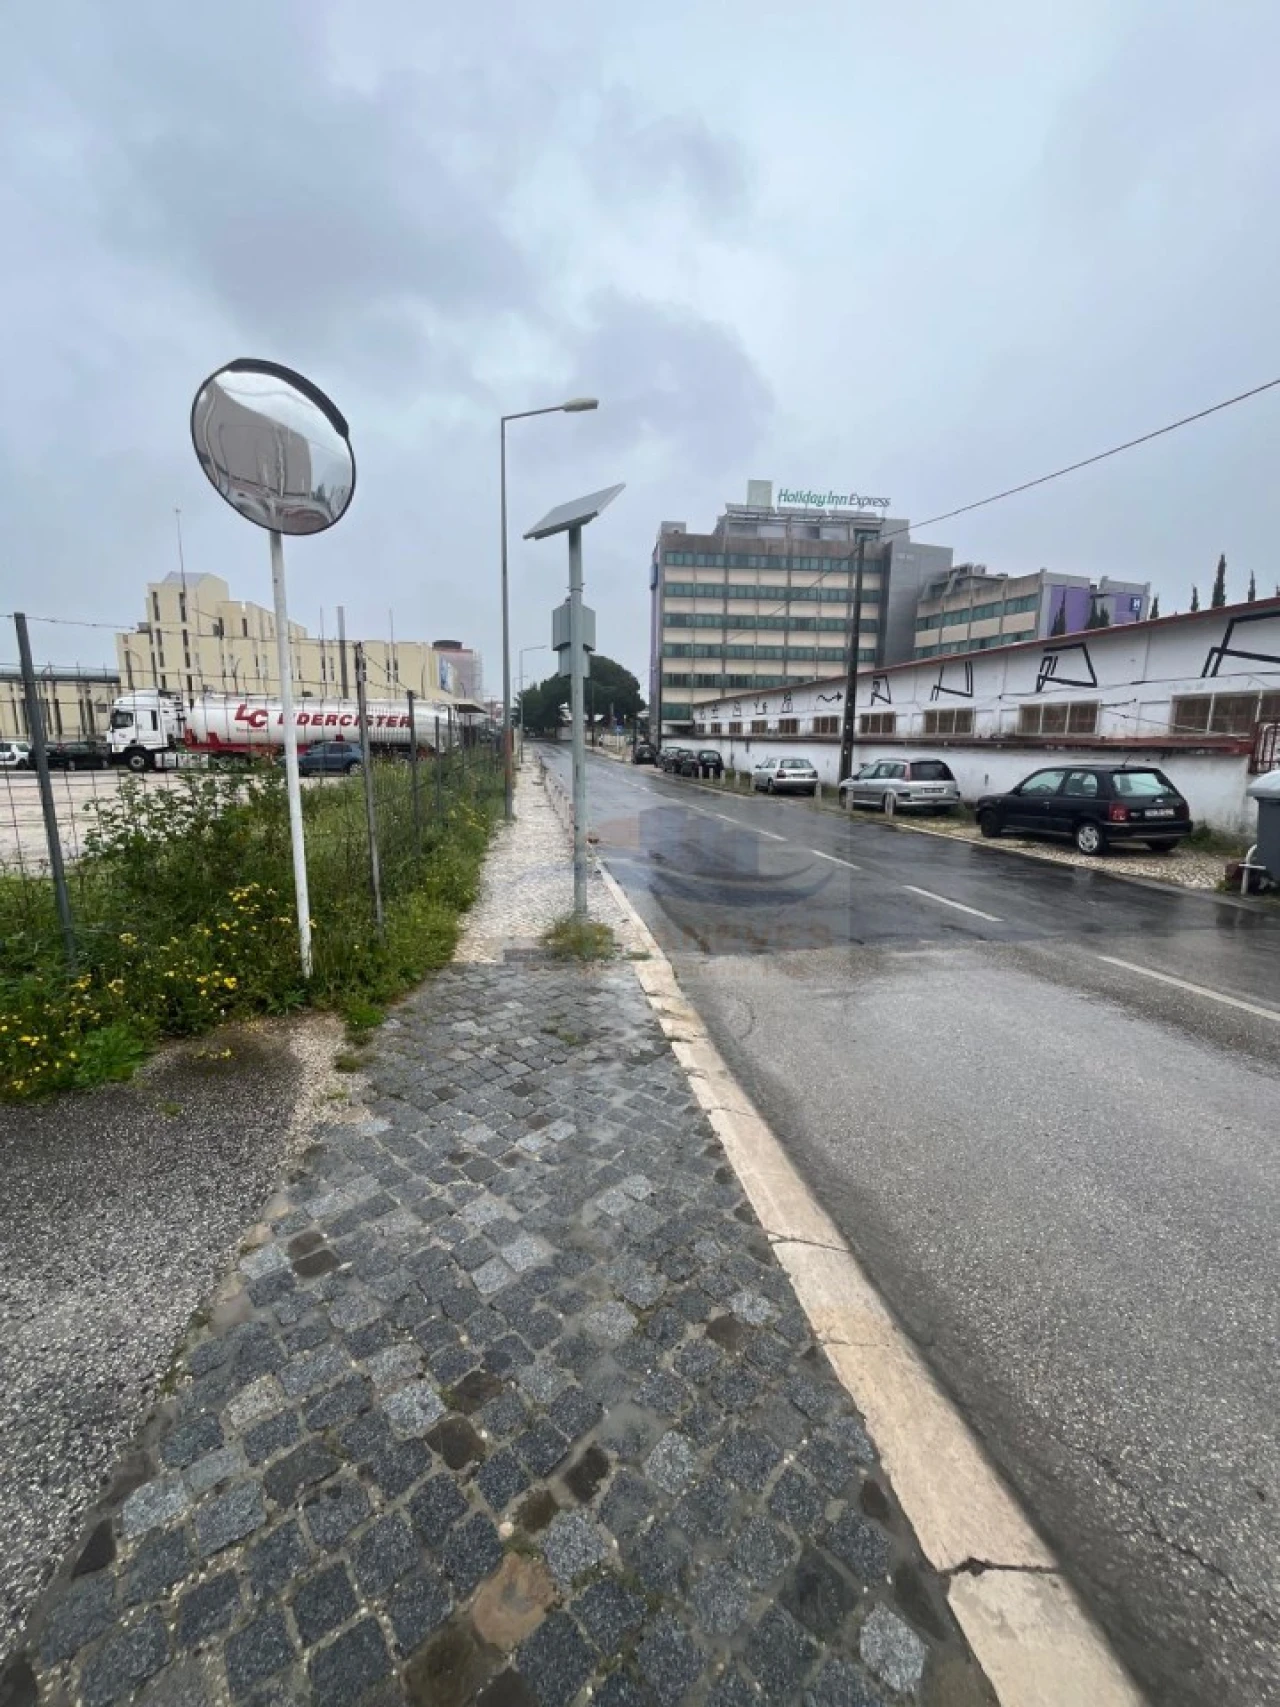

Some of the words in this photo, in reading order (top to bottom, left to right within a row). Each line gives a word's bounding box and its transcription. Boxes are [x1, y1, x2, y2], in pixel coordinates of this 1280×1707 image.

[778, 489, 825, 507] Holiday
[827, 491, 848, 505] Inn
[849, 494, 891, 508] Express
[235, 704, 268, 728] LC
[277, 712, 413, 728] LDERCISTER
